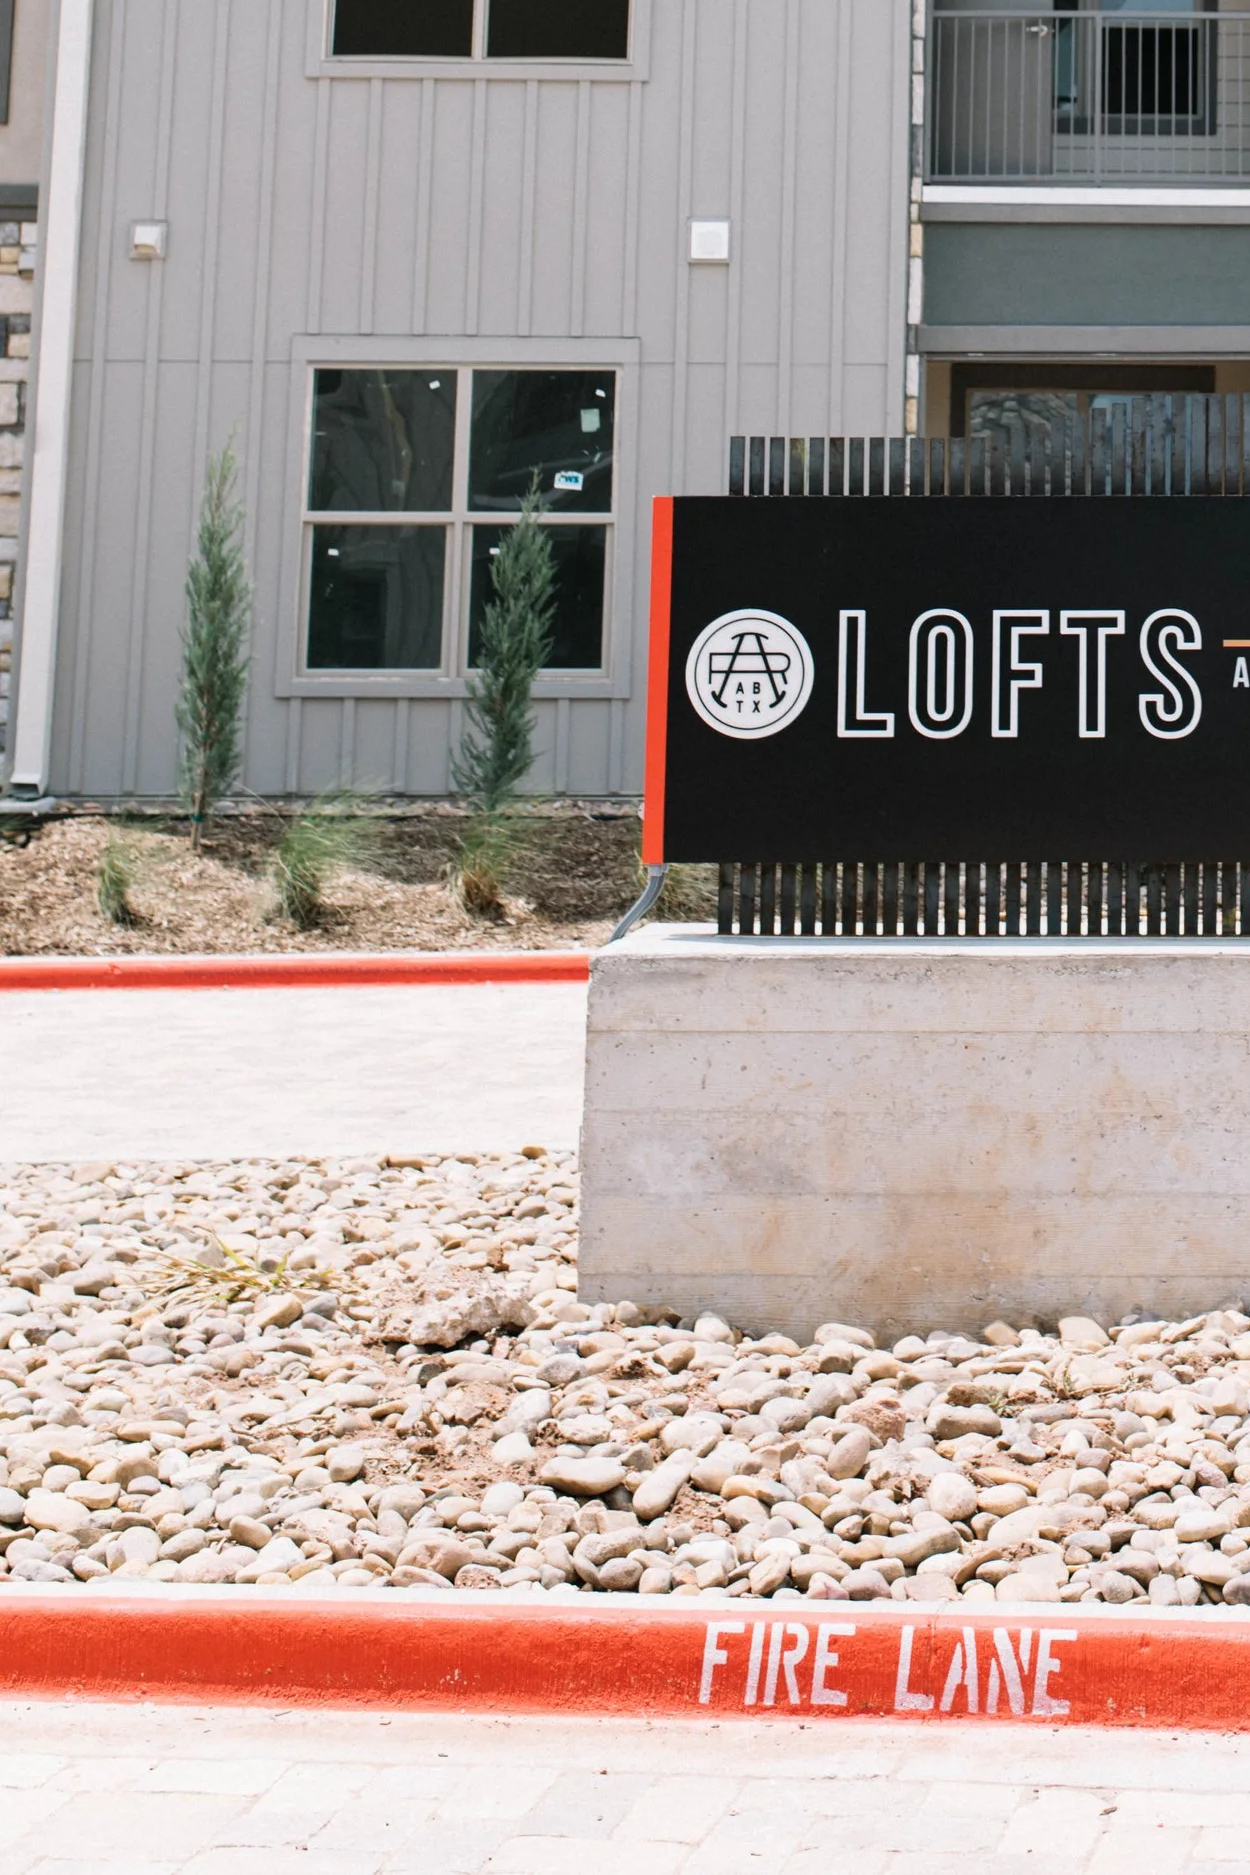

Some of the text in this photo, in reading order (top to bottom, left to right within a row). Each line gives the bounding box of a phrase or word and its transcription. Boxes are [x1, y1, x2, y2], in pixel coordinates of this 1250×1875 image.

[837, 609, 1202, 739] LOFTS
[698, 1620, 1078, 1717] FIRE LANE
